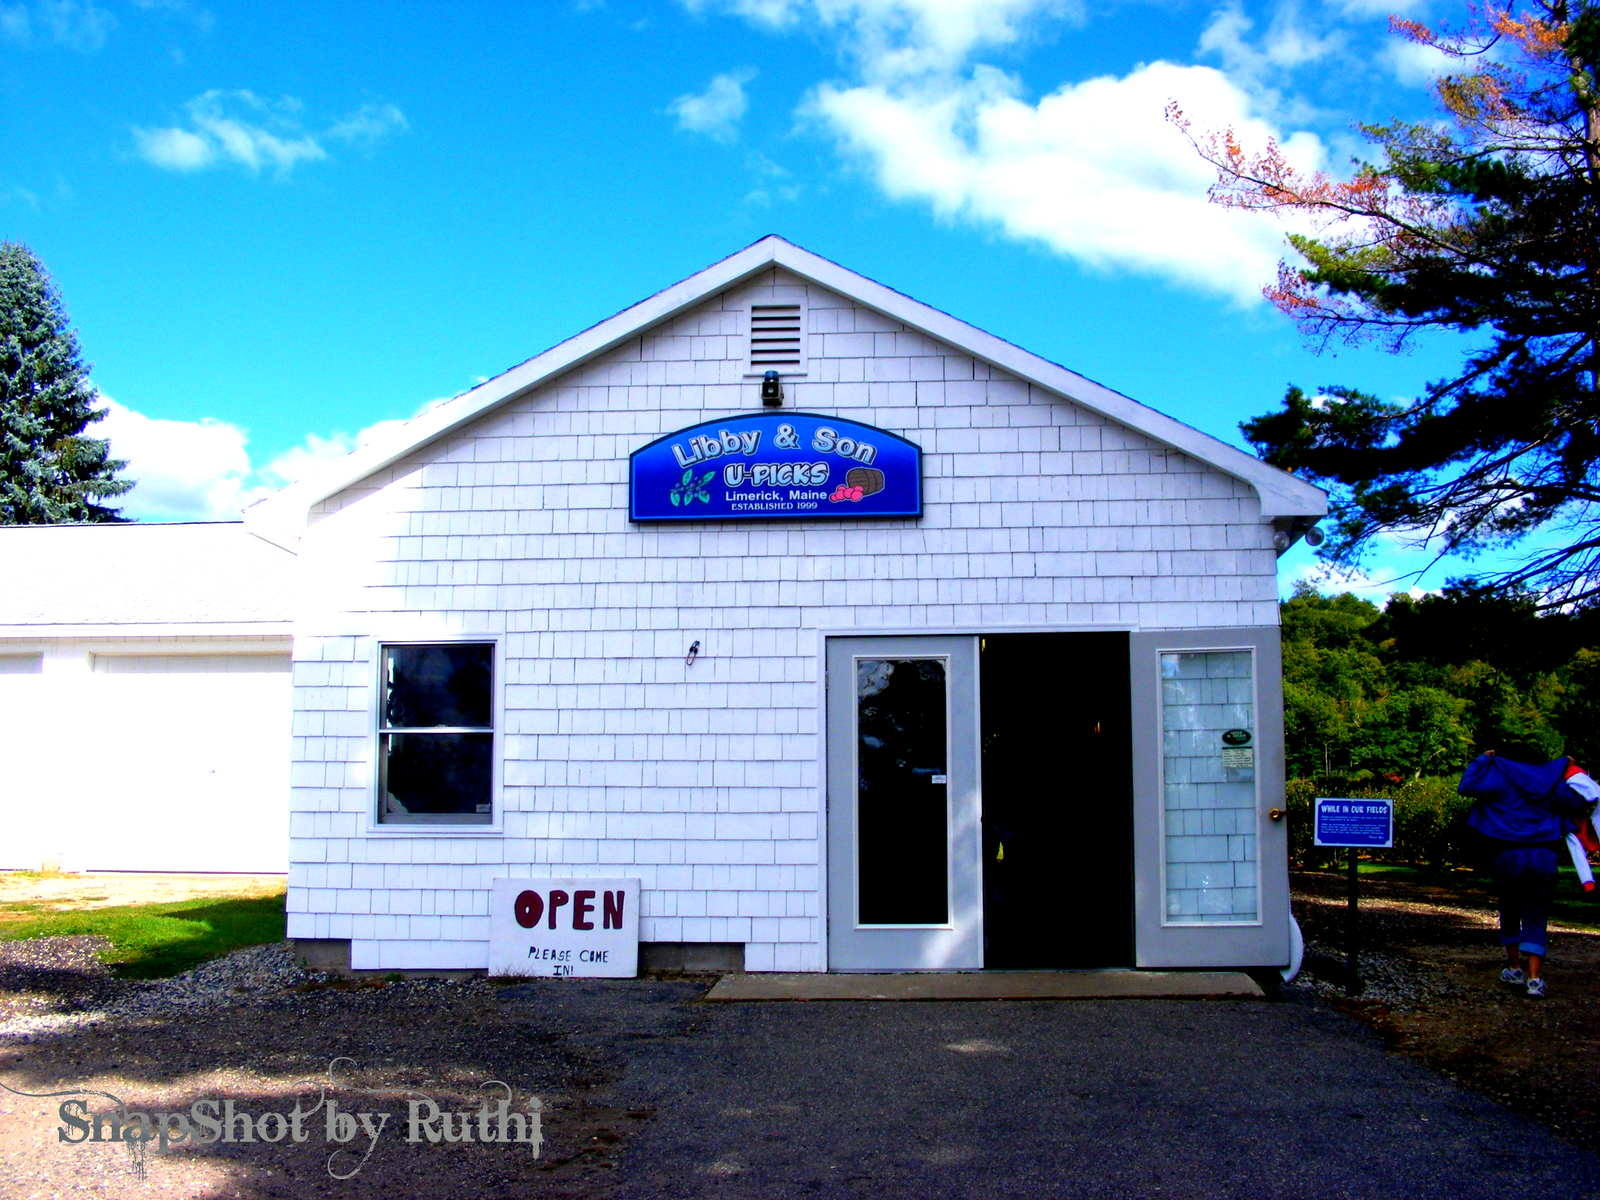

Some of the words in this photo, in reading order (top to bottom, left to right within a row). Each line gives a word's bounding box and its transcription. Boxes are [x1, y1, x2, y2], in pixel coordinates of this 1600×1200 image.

[671, 428, 761, 469] Libby
[773, 423, 801, 449] &
[811, 426, 877, 465] Son
[723, 461, 830, 487] U-PICKS
[725, 490, 784, 502] Limerick,
[789, 489, 828, 501] Maine
[731, 502, 794, 511] ESTABLISHED
[796, 501, 818, 511] 1999
[1321, 805, 1341, 813] WHILE
[1342, 805, 1349, 814] IN
[1350, 805, 1364, 814] OUR
[1366, 806, 1388, 814] FIELDS
[514, 889, 625, 930] OPEN
[528, 946, 572, 962] PLEASE
[579, 949, 609, 963] COME
[553, 965, 574, 976] IN!
